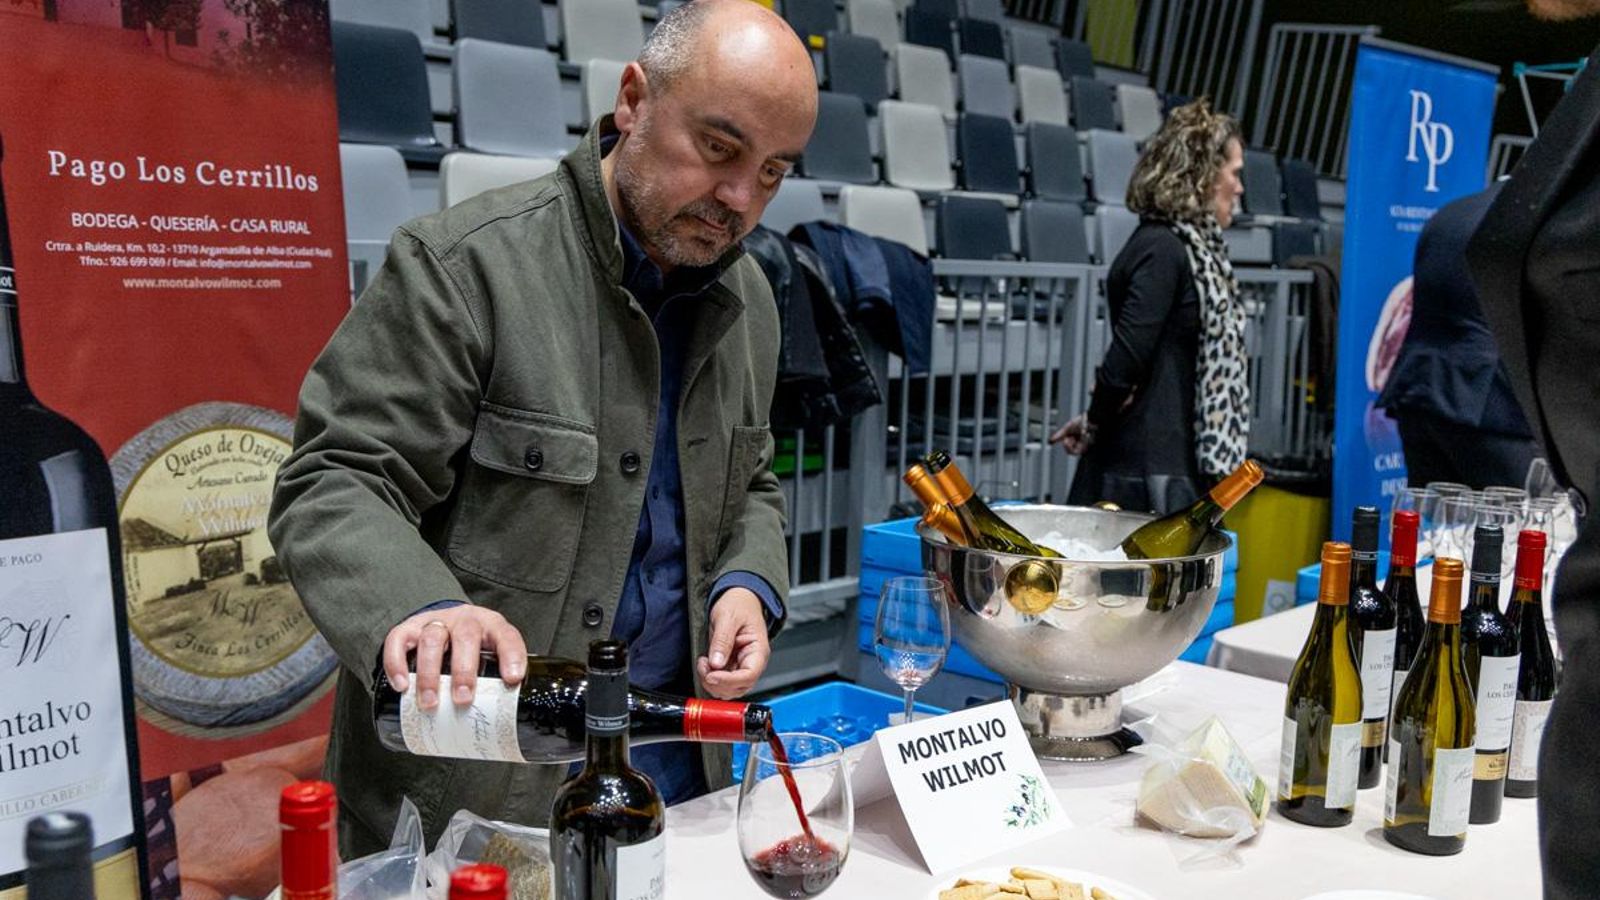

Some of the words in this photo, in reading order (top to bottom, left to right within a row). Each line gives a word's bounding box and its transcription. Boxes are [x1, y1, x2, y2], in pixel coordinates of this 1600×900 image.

[48, 150, 126, 186] Pago
[137, 156, 186, 184] Los
[196, 161, 319, 192] Cerrillos
[71, 212, 139, 229] BODEGA
[150, 213, 219, 232] QUESERÍA
[230, 218, 267, 234] CASA
[270, 220, 311, 235] RURAL
[126, 242, 145, 253] Km.
[172, 244, 199, 255] 13710
[110, 256, 128, 267] 926
[122, 277, 282, 289] www.montalvowilmot.com
[165, 443, 212, 478] Queso
[217, 434, 233, 453] de
[11, 553, 43, 567] PAGO
[897, 717, 1006, 764] MONTALVO
[922, 751, 1007, 793] WILMOT
